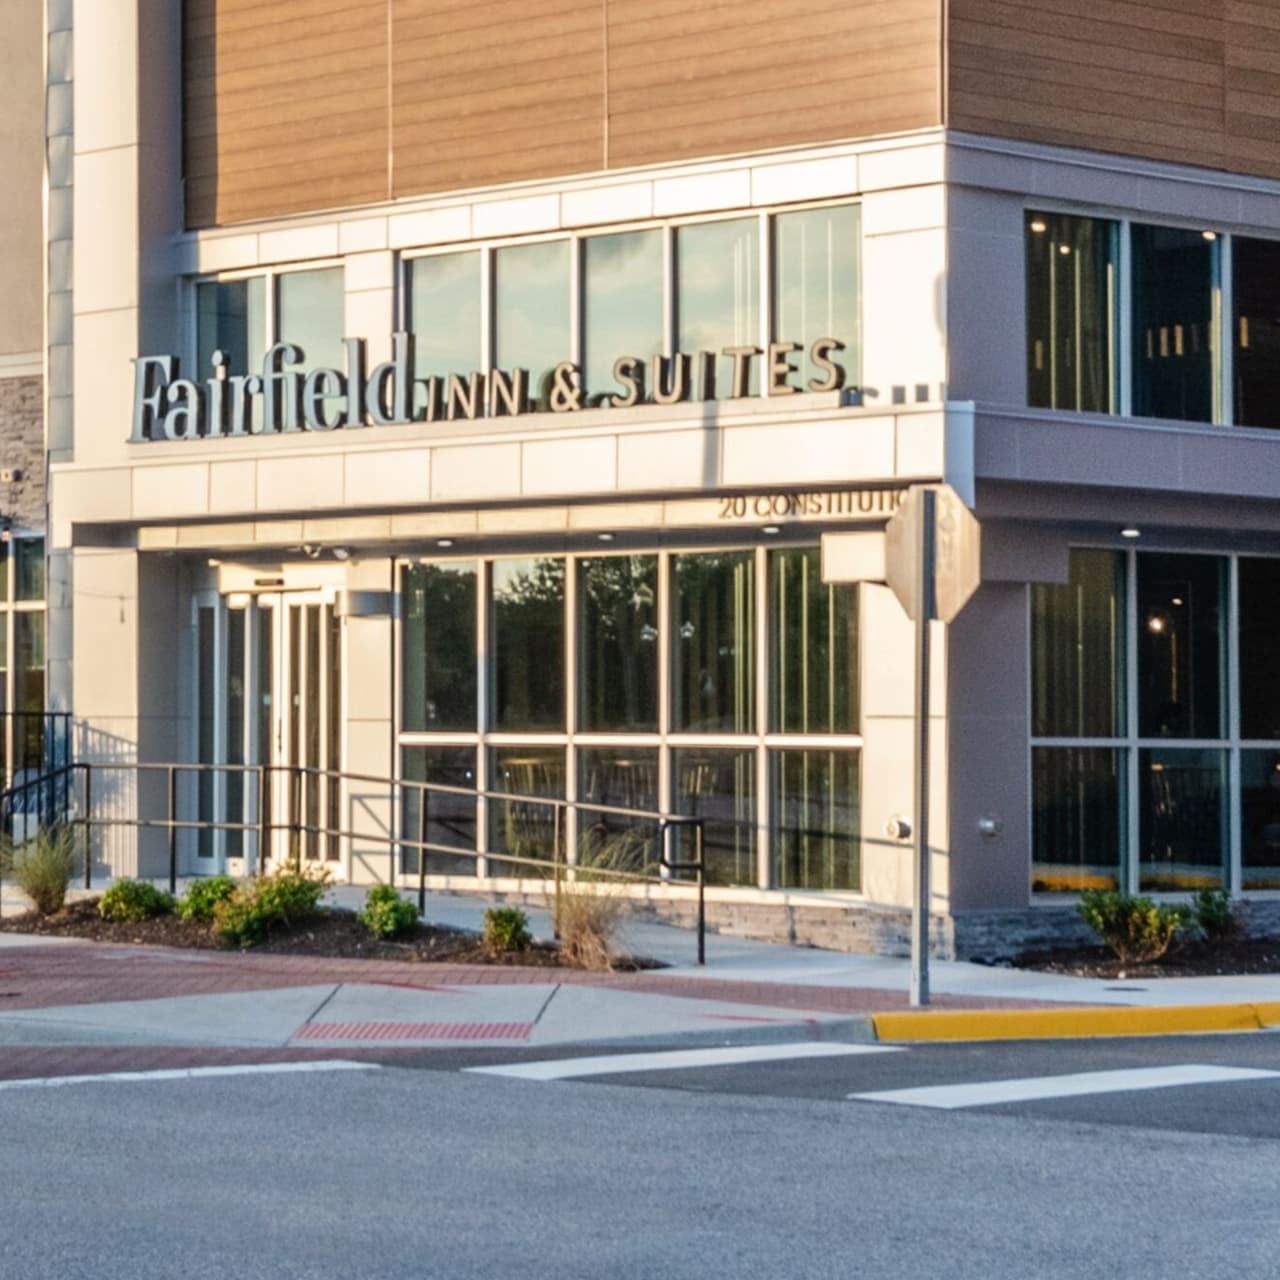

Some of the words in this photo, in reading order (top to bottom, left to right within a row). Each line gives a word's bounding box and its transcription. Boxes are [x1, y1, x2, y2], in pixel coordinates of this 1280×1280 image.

[126, 331, 416, 444] Fairfield
[426, 367, 529, 422] INN
[549, 362, 586, 412] &
[612, 338, 846, 407] SUITES
[719, 497, 747, 519] 20
